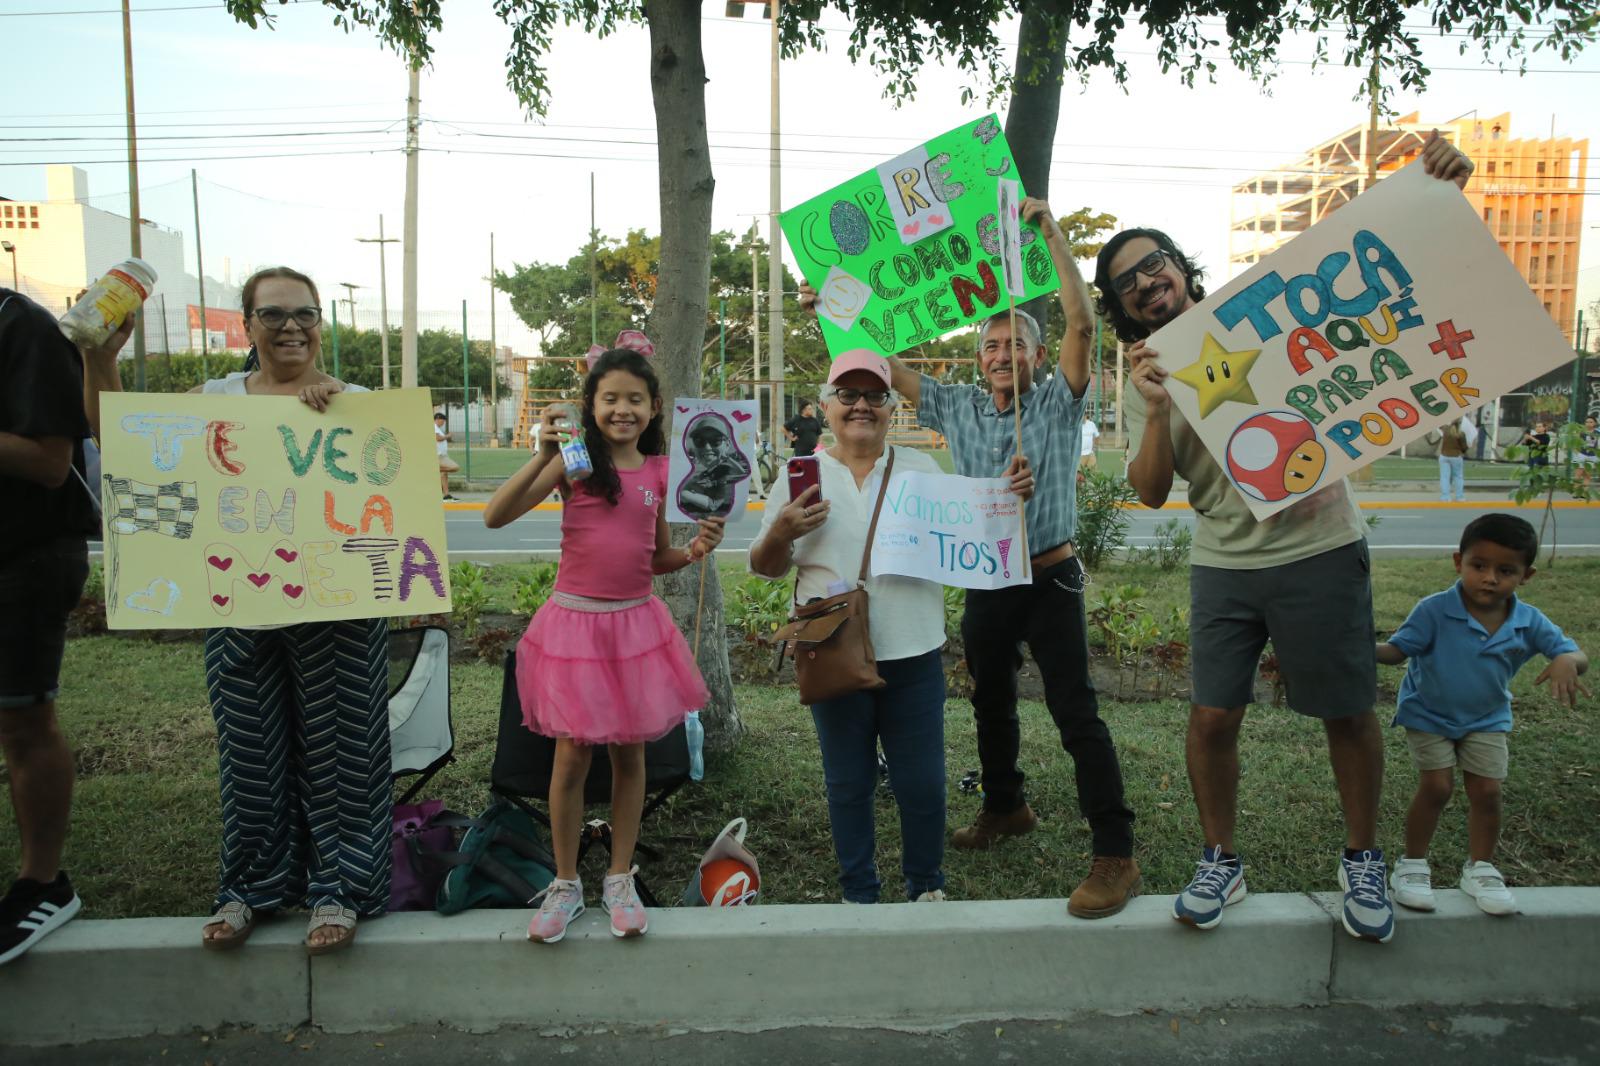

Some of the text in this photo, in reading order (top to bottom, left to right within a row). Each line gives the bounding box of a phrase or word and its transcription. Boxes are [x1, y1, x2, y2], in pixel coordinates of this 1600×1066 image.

[800, 152, 965, 268] CORRE
[859, 244, 1053, 353] VIENO
[869, 232, 972, 300] COMO
[1212, 229, 1414, 343] TOCA
[1286, 347, 1413, 426] PARA
[1325, 367, 1480, 460] PODER
[121, 413, 402, 486] TE VEO
[218, 486, 393, 536] EN LA
[885, 479, 974, 525] Vamos
[204, 536, 446, 617] META
